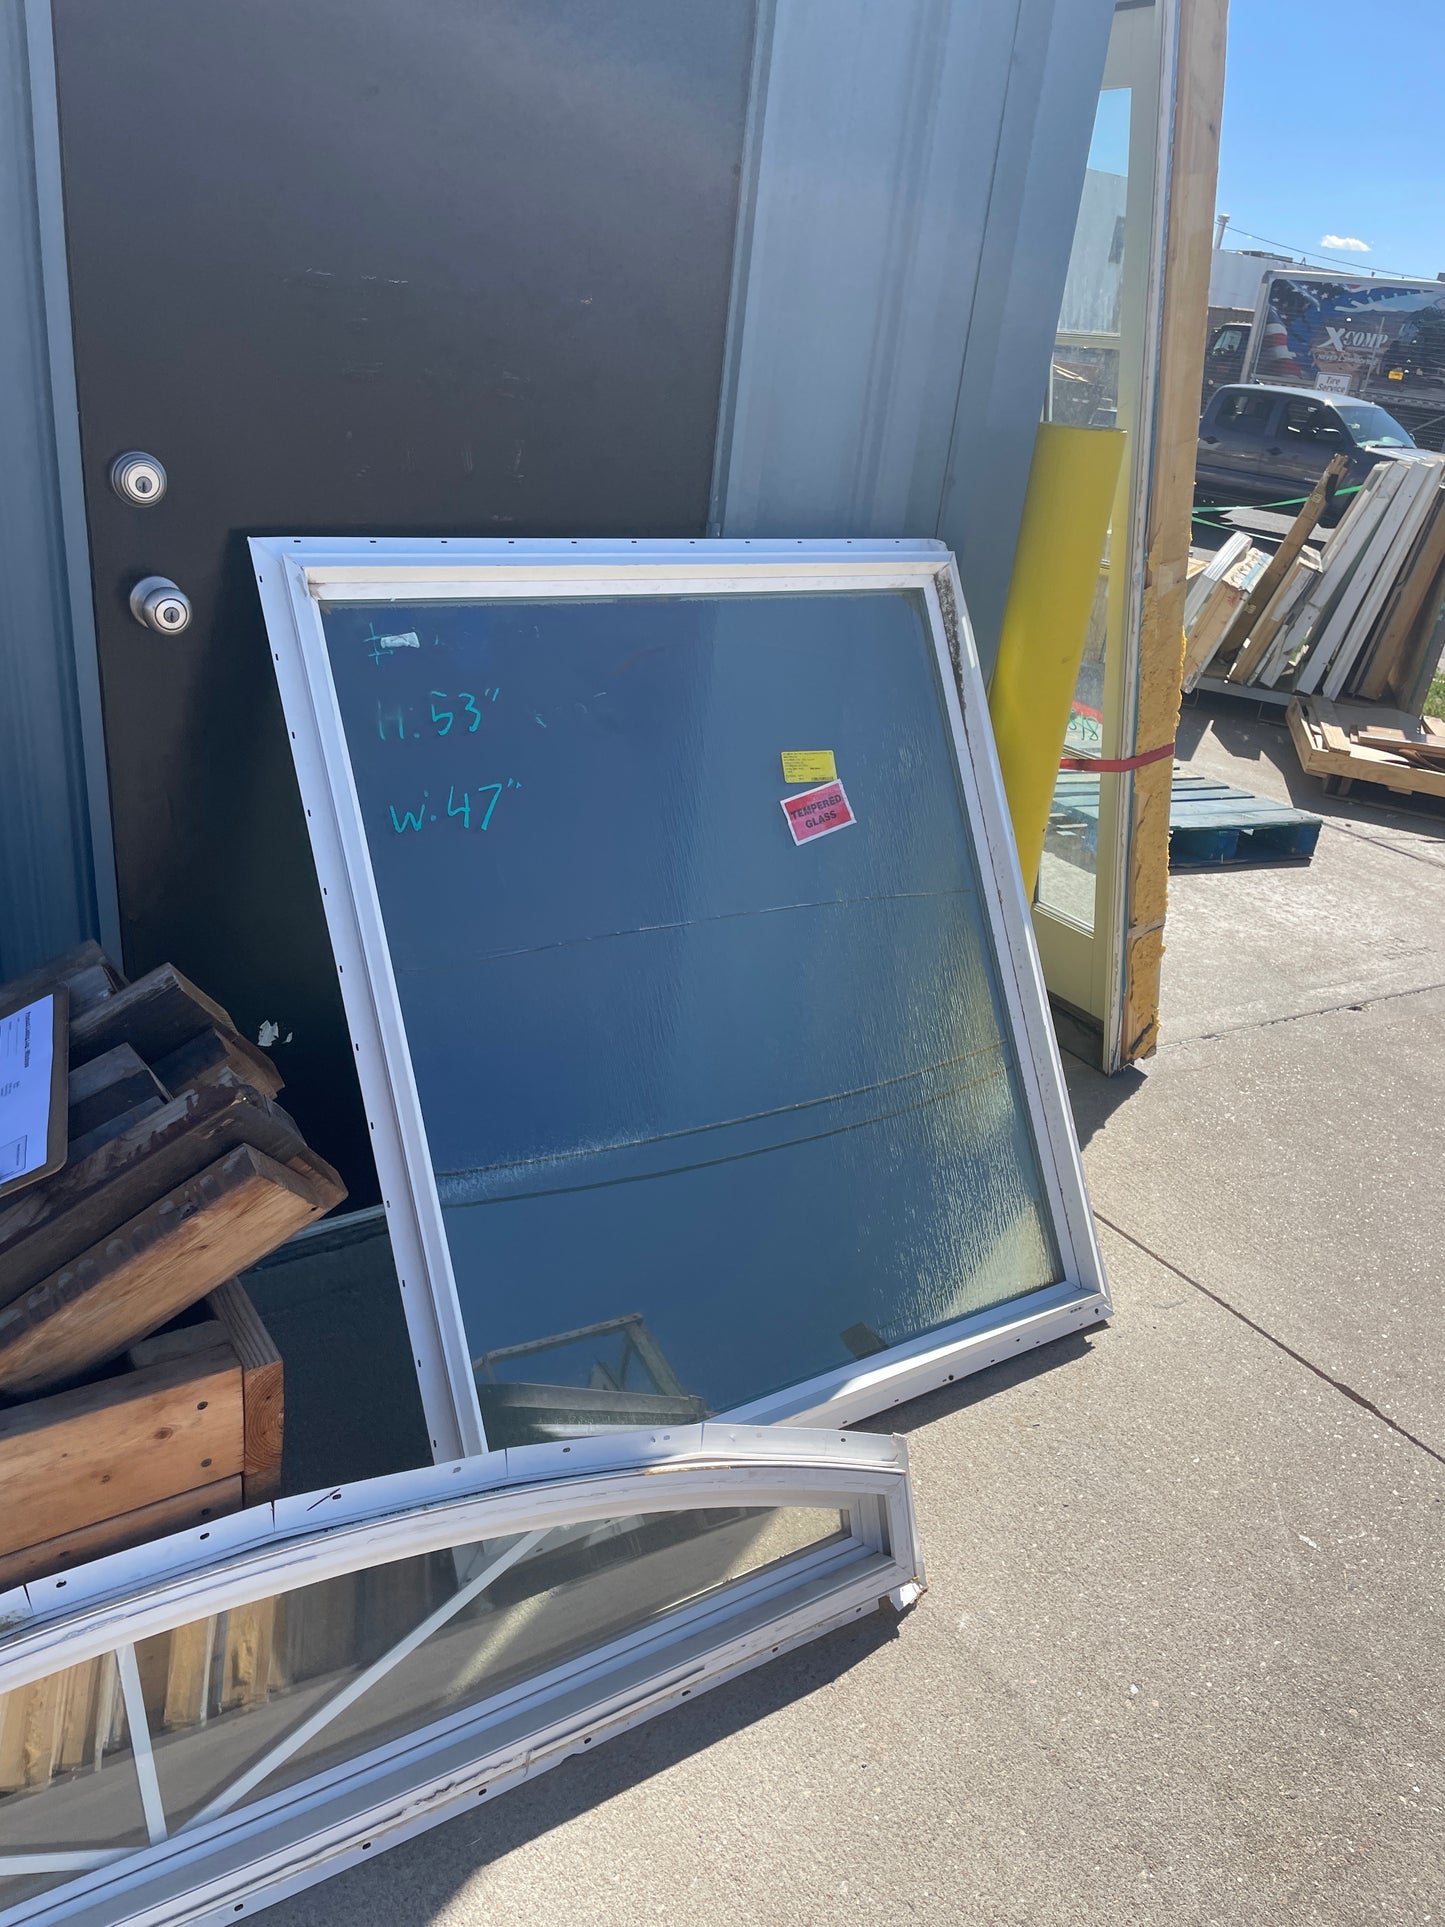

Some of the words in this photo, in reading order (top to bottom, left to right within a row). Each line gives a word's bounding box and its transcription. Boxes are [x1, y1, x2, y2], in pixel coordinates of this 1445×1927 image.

[1326, 376, 1341, 385] Tire
[1317, 384, 1346, 393] Service
[790, 794, 842, 820] TEMPERED
[805, 810, 838, 829] GLASS
